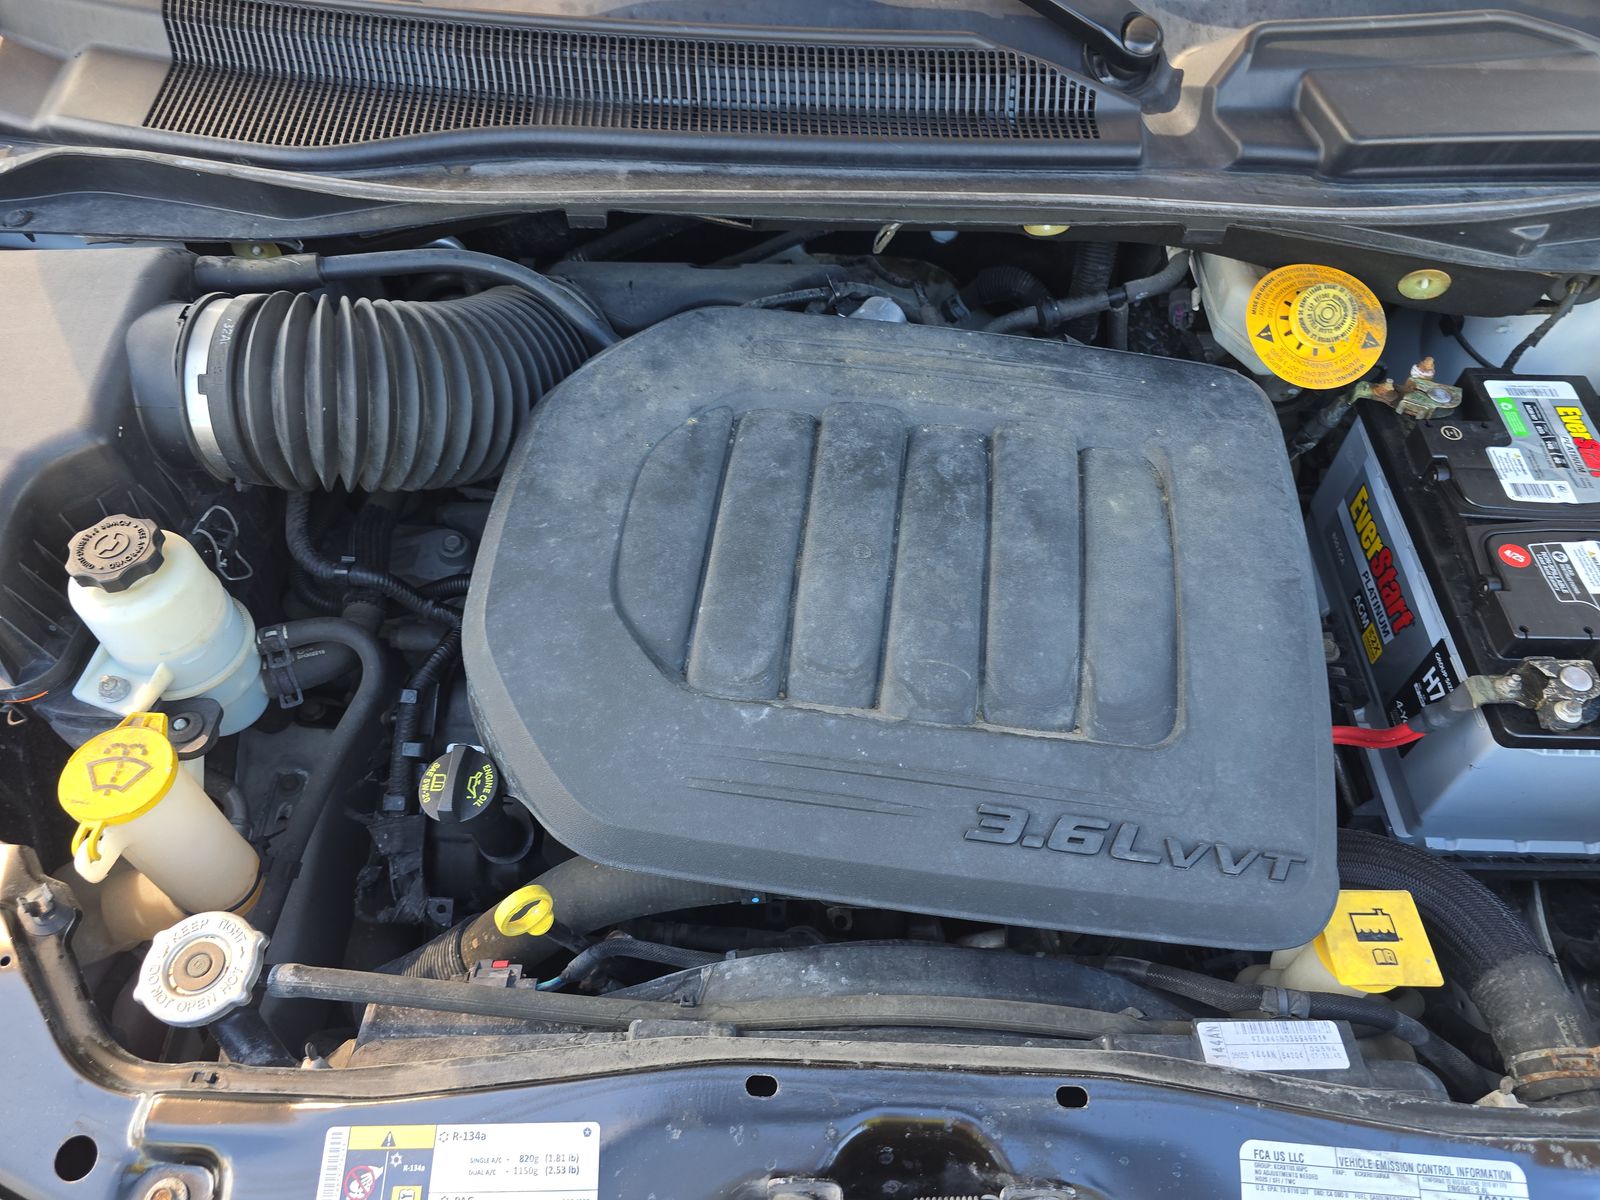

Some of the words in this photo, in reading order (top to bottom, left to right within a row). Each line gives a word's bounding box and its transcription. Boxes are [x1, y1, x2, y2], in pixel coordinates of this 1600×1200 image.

[1350, 484, 1415, 636] EverStart
[1353, 594, 1370, 629] AGM
[1361, 571, 1391, 638] PLATINUM
[1422, 666, 1446, 701] H7
[426, 762, 441, 777] SAE
[482, 764, 494, 794] ENGINE
[472, 794, 488, 807] OIL
[173, 919, 209, 943] KEEP
[217, 918, 248, 943] TIGHT
[176, 993, 217, 1013] OPEN
[452, 1131, 487, 1142] R-134a
[519, 1154, 540, 1165] 820g
[545, 1153, 566, 1164] (1.81
[568, 1153, 580, 1164] lb)
[1253, 1149, 1272, 1161] FCA
[1273, 1150, 1286, 1162] US
[1288, 1151, 1304, 1163] LLC
[513, 1166, 539, 1177] 1150g
[545, 1165, 566, 1177] (2.53
[568, 1165, 580, 1176] lb)
[1339, 1156, 1373, 1169] VEHICLE
[1375, 1159, 1414, 1173] EMISSION
[1416, 1162, 1455, 1176] CONTROL
[1456, 1166, 1512, 1180] INFORMATION
